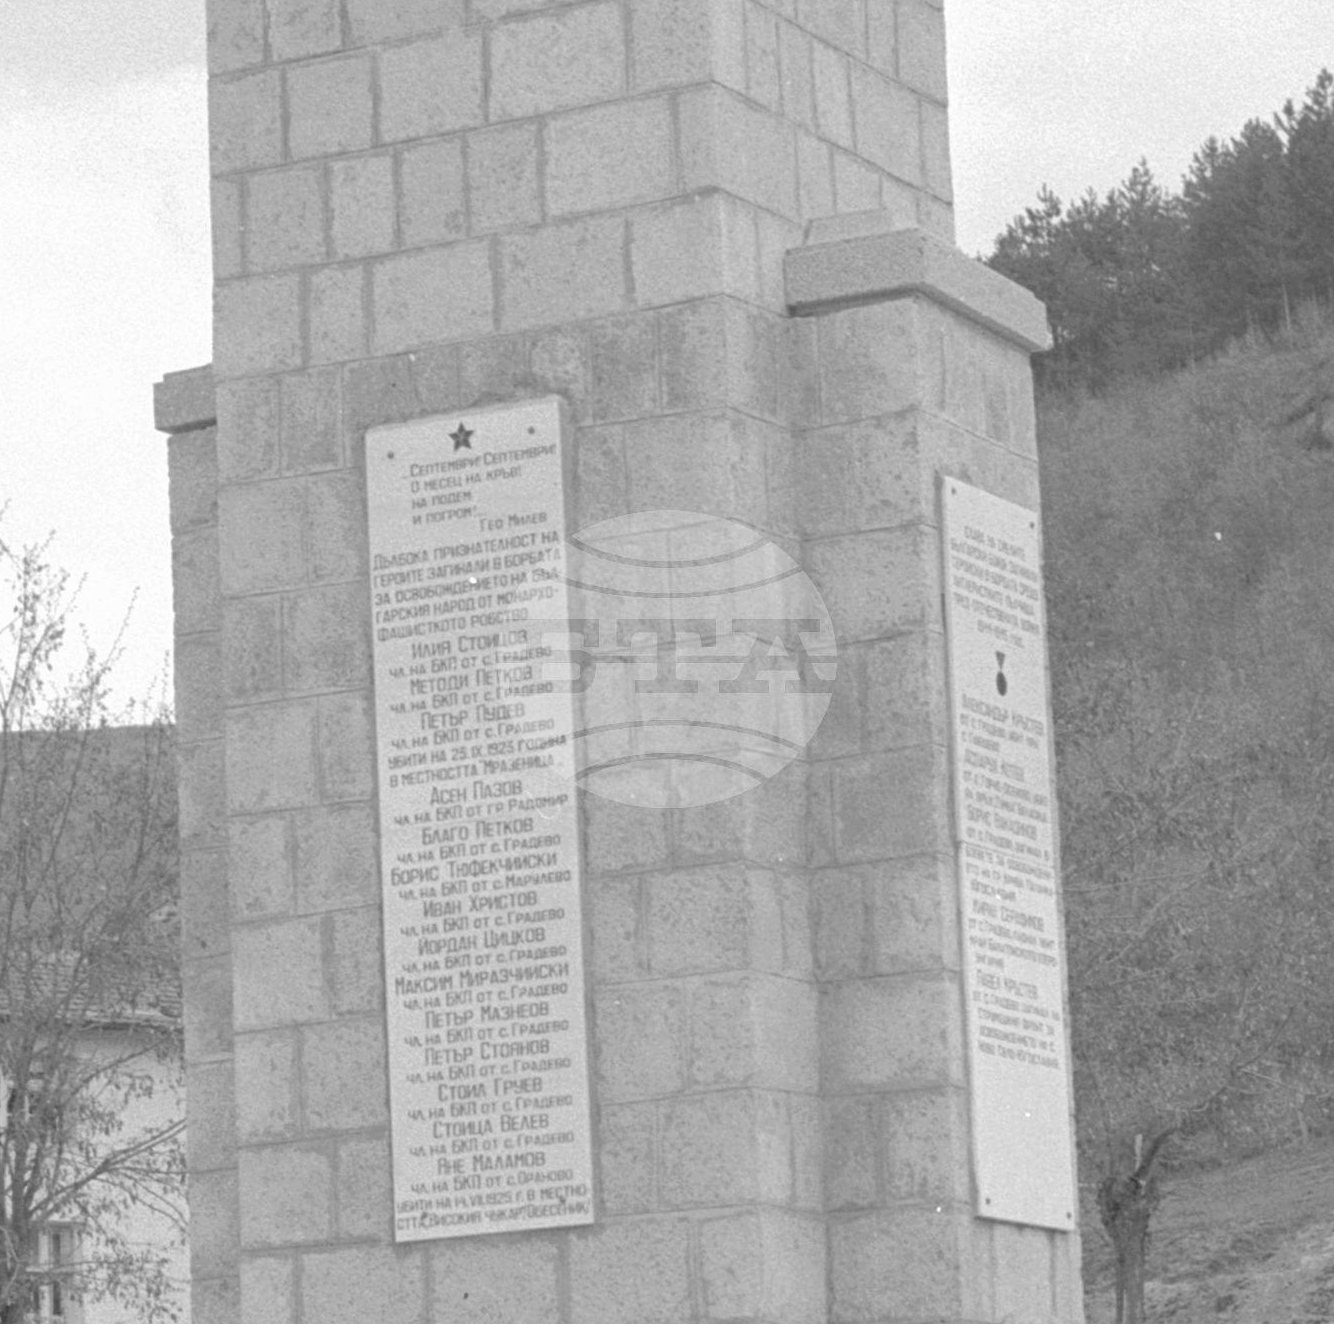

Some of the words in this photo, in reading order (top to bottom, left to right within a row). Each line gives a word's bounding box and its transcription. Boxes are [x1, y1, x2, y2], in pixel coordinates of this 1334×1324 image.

[423, 474, 463, 492] МЕСЕЦ
[466, 472, 481, 484] НА
[412, 497, 427, 509] НА
[431, 489, 472, 507] ПОДЕМ
[412, 515, 422, 525] И
[480, 518, 503, 532] ГЕО
[508, 511, 548, 528] МИЛЕВ
[373, 548, 429, 570] ДЪЛБОКА
[434, 531, 538, 561] ПРИЗНАТЕЛНОСТ
[541, 529, 560, 544] НА
[374, 568, 424, 589] ГЕРОИТЕ
[427, 558, 490, 581] ЗАГИНАЛИ
[492, 556, 502, 570] В
[504, 546, 561, 568] БОРБАТА
[375, 591, 391, 606] ЗА
[510, 570, 528, 585] НА
[376, 603, 431, 624] ГАРСКИЯ
[433, 596, 476, 616] НАРОД
[478, 594, 494, 608] ОТ
[412, 640, 451, 659] ИЛИЯ
[410, 674, 470, 697] МЕТОДИ
[421, 710, 469, 730] ПЕТЪР
[412, 736, 429, 748] НА
[433, 728, 460, 745] БКП
[464, 728, 481, 741] ОТ
[387, 752, 428, 770] УБИТИ
[430, 749, 448, 763] НА
[389, 774, 399, 787] В
[429, 787, 467, 806] АСЕН
[415, 812, 432, 824] НА
[436, 805, 463, 821] БКП
[466, 805, 483, 817] ОТ
[422, 825, 469, 845] БЛАГО
[475, 816, 534, 838] ПЕТКОВ
[417, 850, 435, 862] НА
[440, 843, 467, 859] БКП
[470, 843, 487, 855] ОТ
[390, 866, 440, 887] БОРИС
[419, 886, 437, 899] НА
[441, 880, 468, 896] БКП
[471, 880, 489, 892] ОТ
[423, 900, 463, 919] ИВАН
[469, 890, 539, 913] ХРИСТОВ
[421, 923, 439, 936] НА
[443, 916, 470, 933] БКП
[473, 917, 491, 929] ОТ
[423, 960, 441, 972] НА
[444, 953, 472, 970] БКП
[475, 953, 493, 966] ОТ
[394, 975, 454, 996] МАКСИМ
[424, 997, 442, 1009] НА
[446, 990, 473, 1007] БКП
[476, 991, 494, 1003] ОТ
[425, 1010, 474, 1029] ПЕТЪР
[425, 1033, 442, 1046] НА
[446, 1027, 474, 1043] БКП
[477, 1027, 495, 1040] ОТ
[424, 1047, 474, 1066] ПЕТЪР
[427, 1070, 445, 1082] НА
[449, 1064, 476, 1080] БКП
[479, 1065, 497, 1077] ОТ
[428, 1107, 446, 1120] НА
[450, 1101, 477, 1117] БКП
[481, 1102, 498, 1114] ОТ
[430, 1144, 447, 1156] НА
[452, 1138, 479, 1154] БКП
[482, 1139, 500, 1151] ОТ
[432, 1181, 449, 1193] НА
[453, 1175, 482, 1191] БКП
[485, 1176, 503, 1188] ОТ
